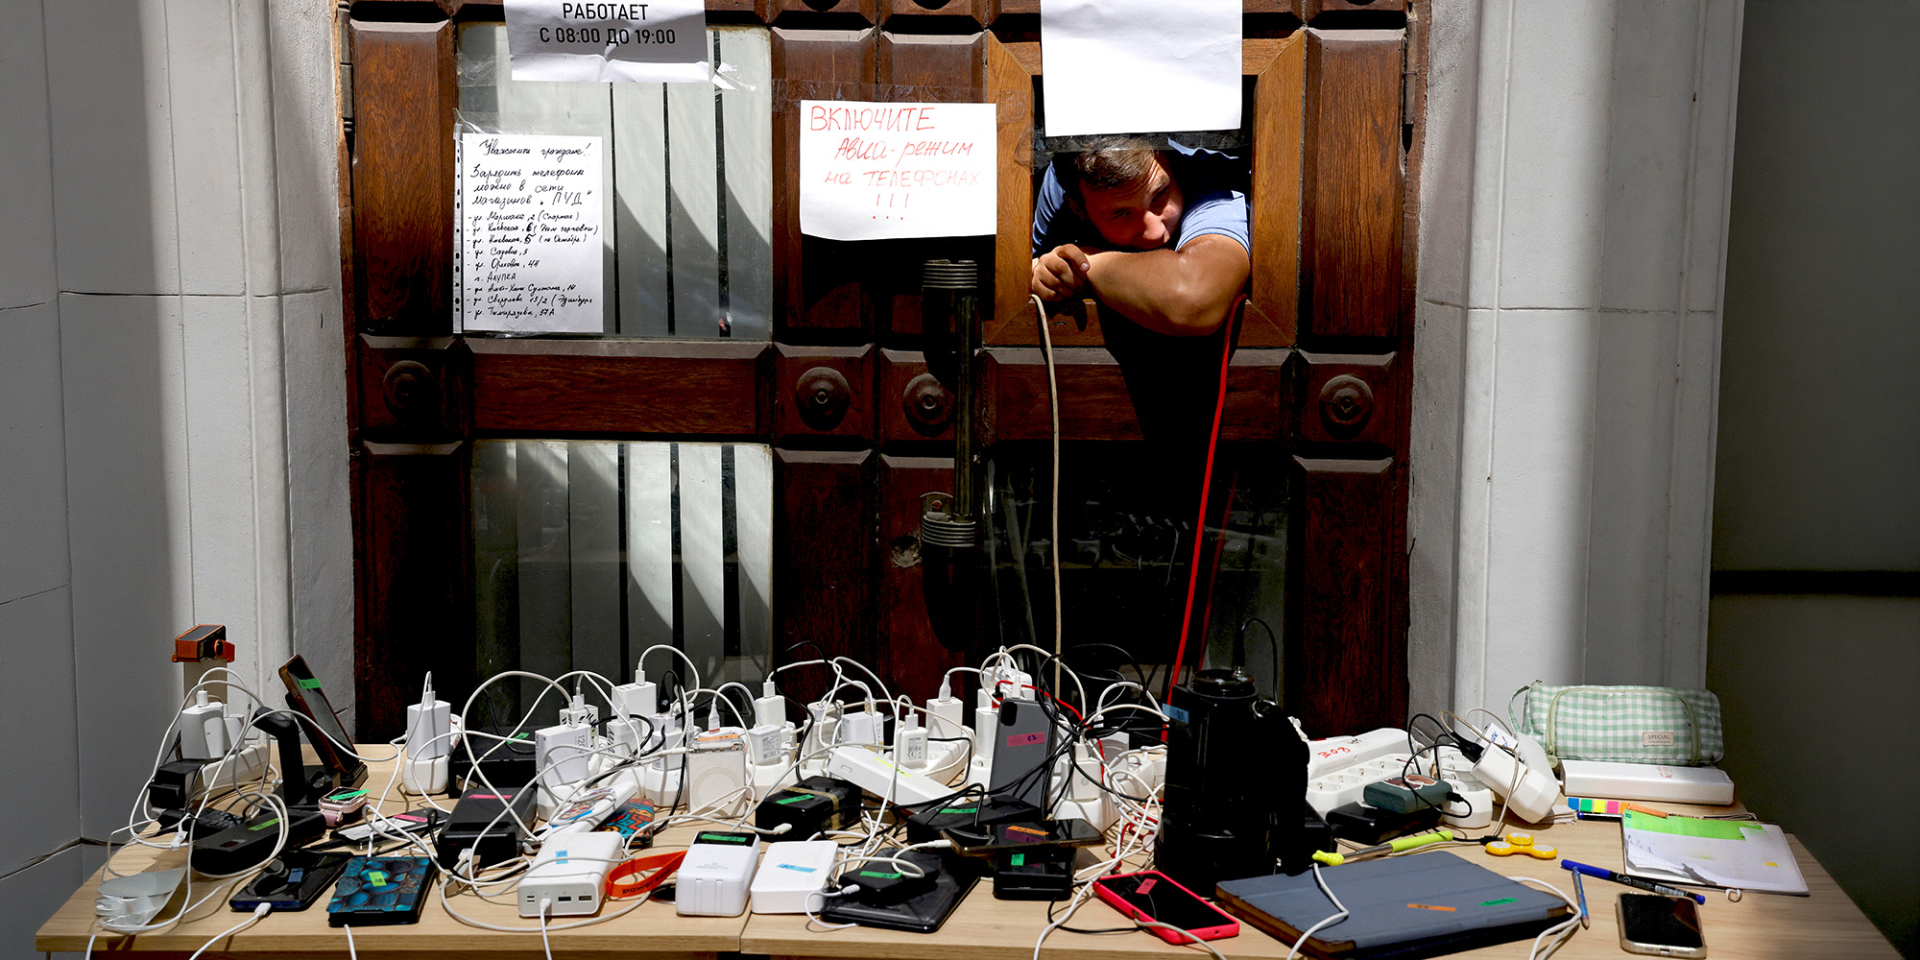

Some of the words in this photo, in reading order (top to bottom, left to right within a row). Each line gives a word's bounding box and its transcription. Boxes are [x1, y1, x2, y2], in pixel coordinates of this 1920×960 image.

[562, 3, 649, 20] РАБОТАЕТ
[539, 27, 551, 43] С
[555, 27, 601, 44] 08:00
[606, 28, 630, 47] ДО
[636, 29, 676, 45] 19:00
[809, 105, 936, 132] ВКЛЮЧИТЕ
[470, 163, 522, 184] Зарядить
[532, 168, 585, 180] телефоны
[824, 171, 853, 185] на
[862, 169, 981, 187] ТЕЛЕФОНАХ
[473, 182, 512, 192] можно
[534, 185, 565, 194] сети
